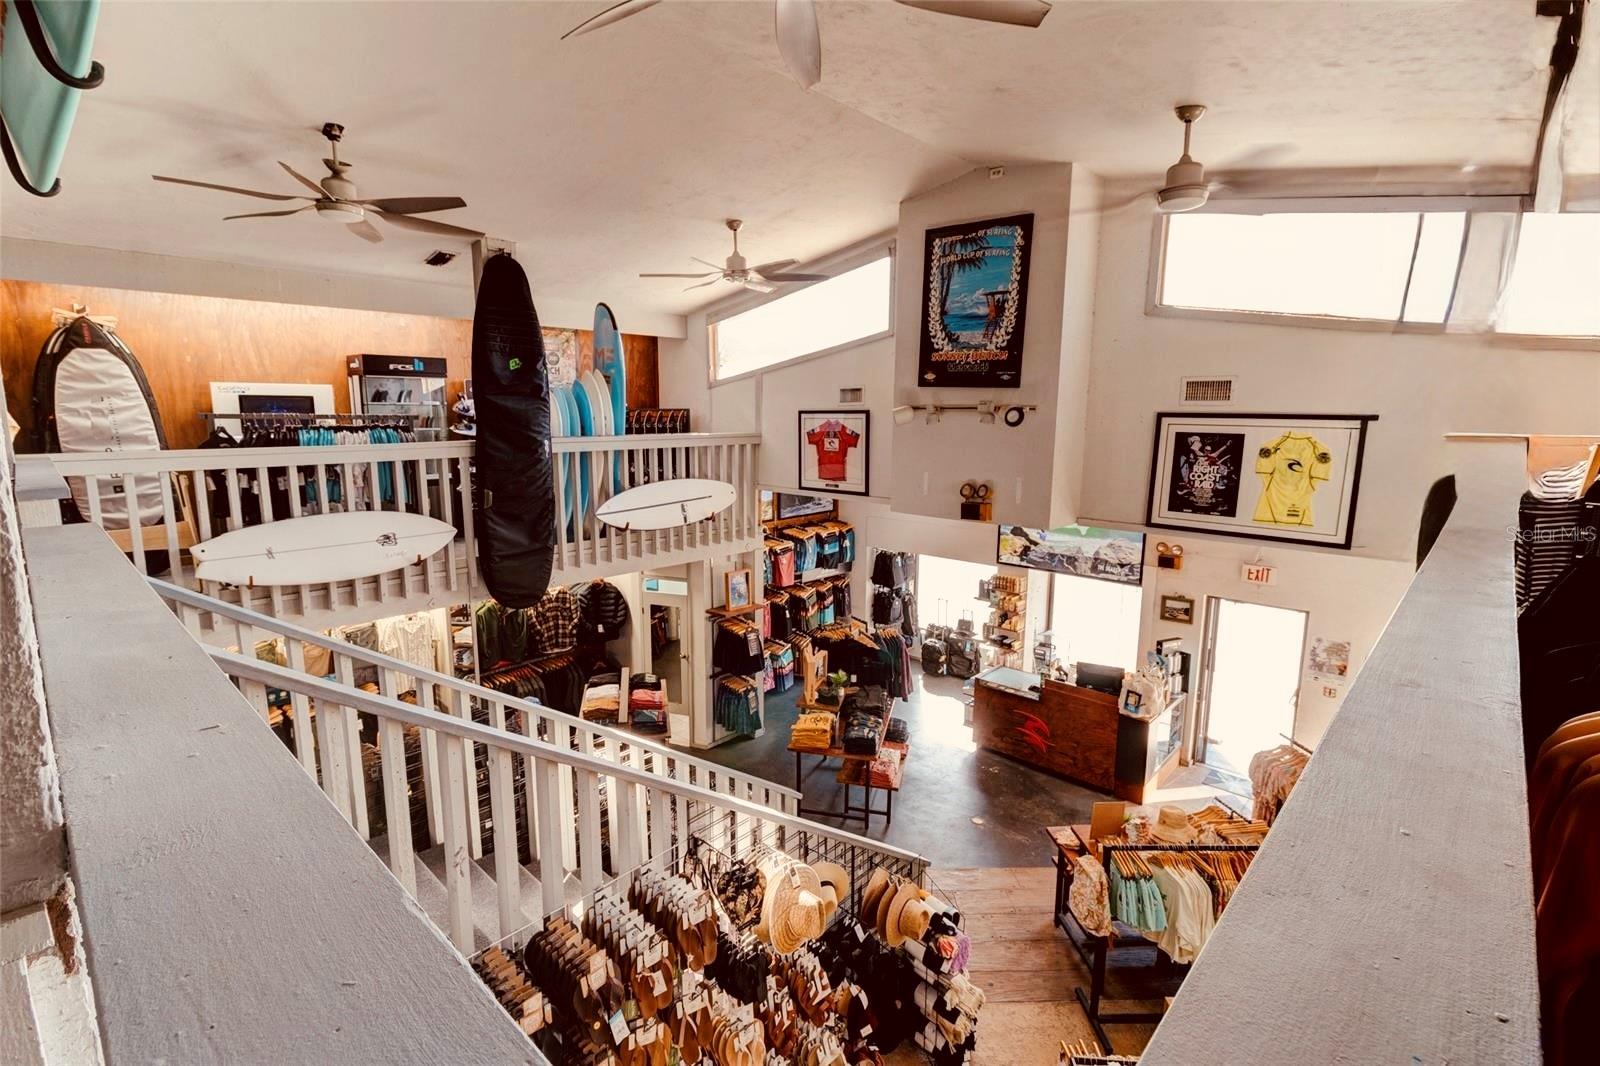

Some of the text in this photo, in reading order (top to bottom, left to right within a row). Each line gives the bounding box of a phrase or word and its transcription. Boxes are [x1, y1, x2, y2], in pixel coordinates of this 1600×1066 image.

[1193, 465, 1220, 474] RIGHT
[1189, 472, 1222, 482] COAST
[1247, 567, 1272, 583] EXIT
